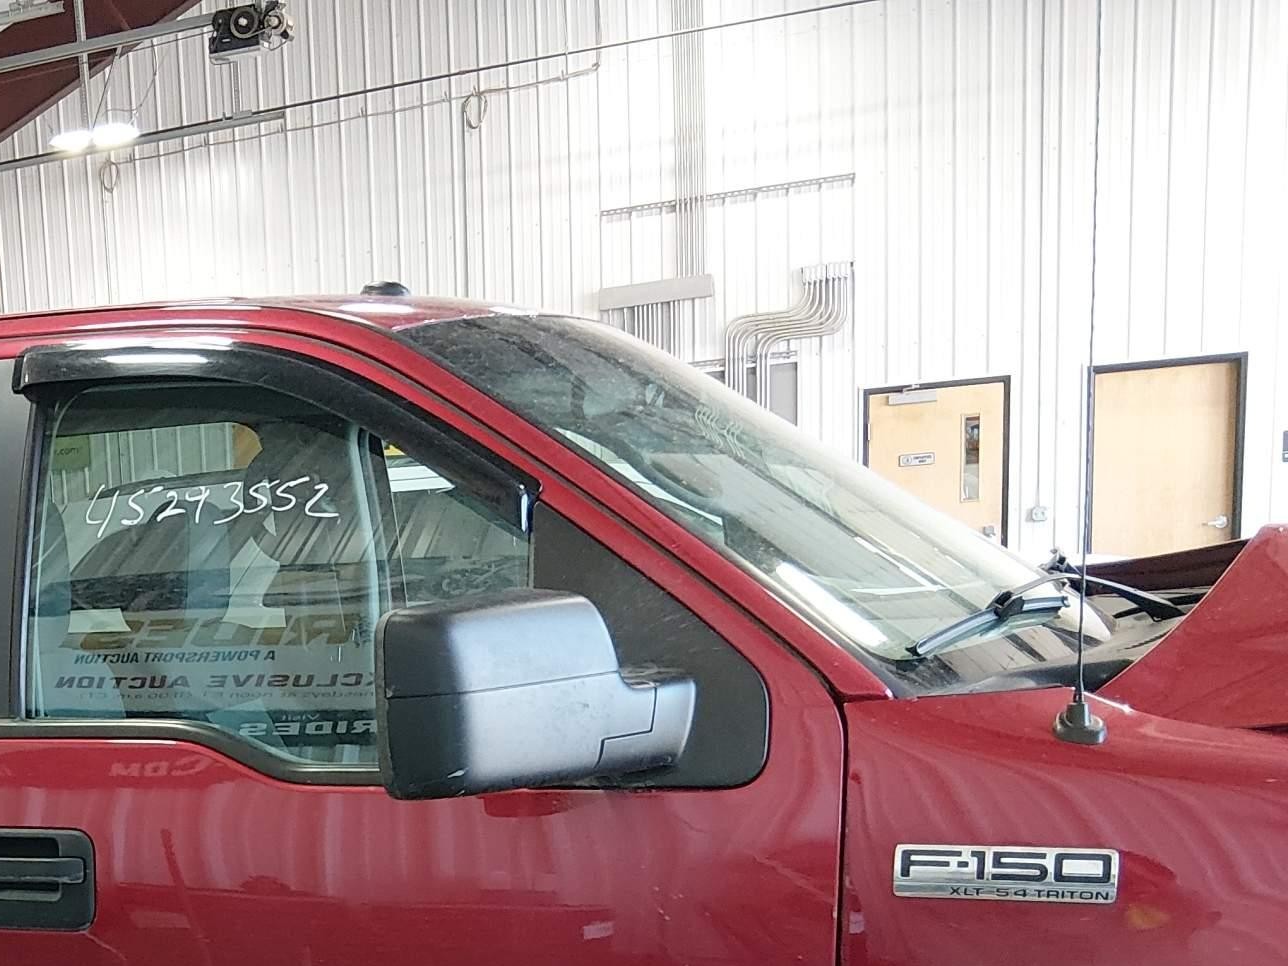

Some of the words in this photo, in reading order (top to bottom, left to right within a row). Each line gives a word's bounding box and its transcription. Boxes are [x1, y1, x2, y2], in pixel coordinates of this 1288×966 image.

[86, 476, 340, 538] 45293552
[900, 848, 1113, 884] F-150
[950, 886, 983, 897] XLT
[1034, 889, 1110, 901] TRITON
